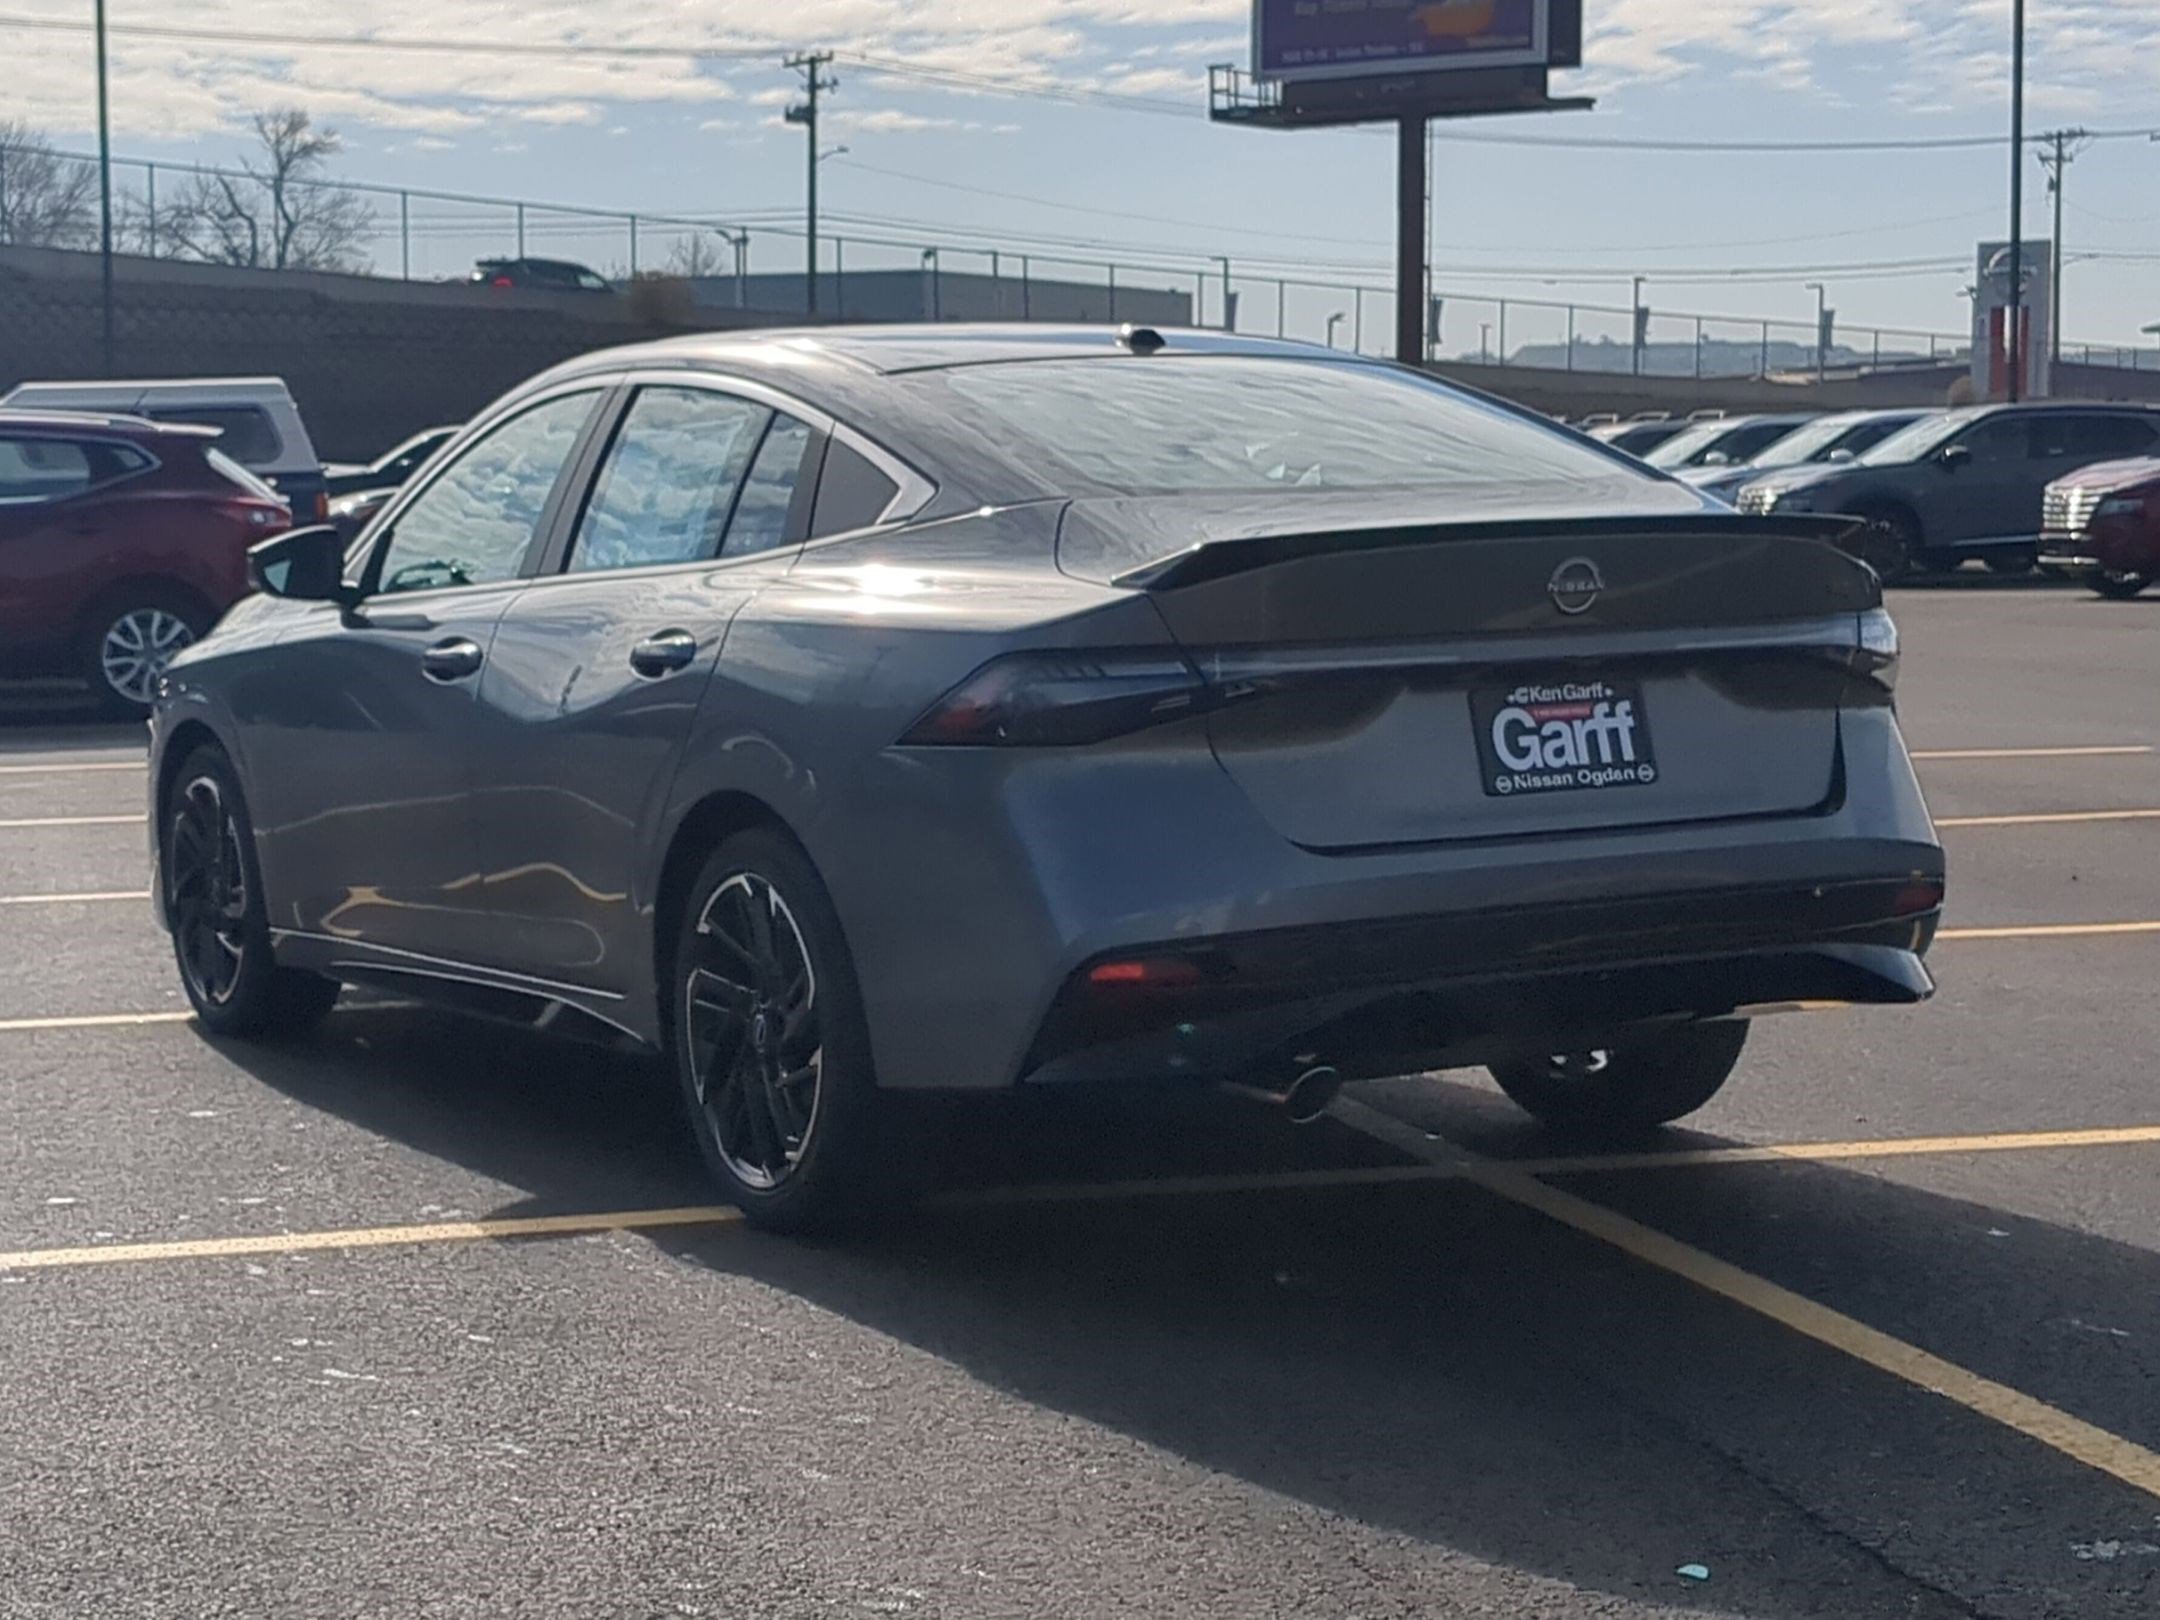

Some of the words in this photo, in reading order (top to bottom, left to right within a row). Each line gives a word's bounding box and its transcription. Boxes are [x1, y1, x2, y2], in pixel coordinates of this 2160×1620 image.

[1530, 687, 1561, 701] Ken
[1563, 683, 1603, 699] Garff
[1492, 700, 1635, 771] Garff
[1514, 774, 1573, 789] Nissan
[1577, 768, 1635, 786] Ogden
